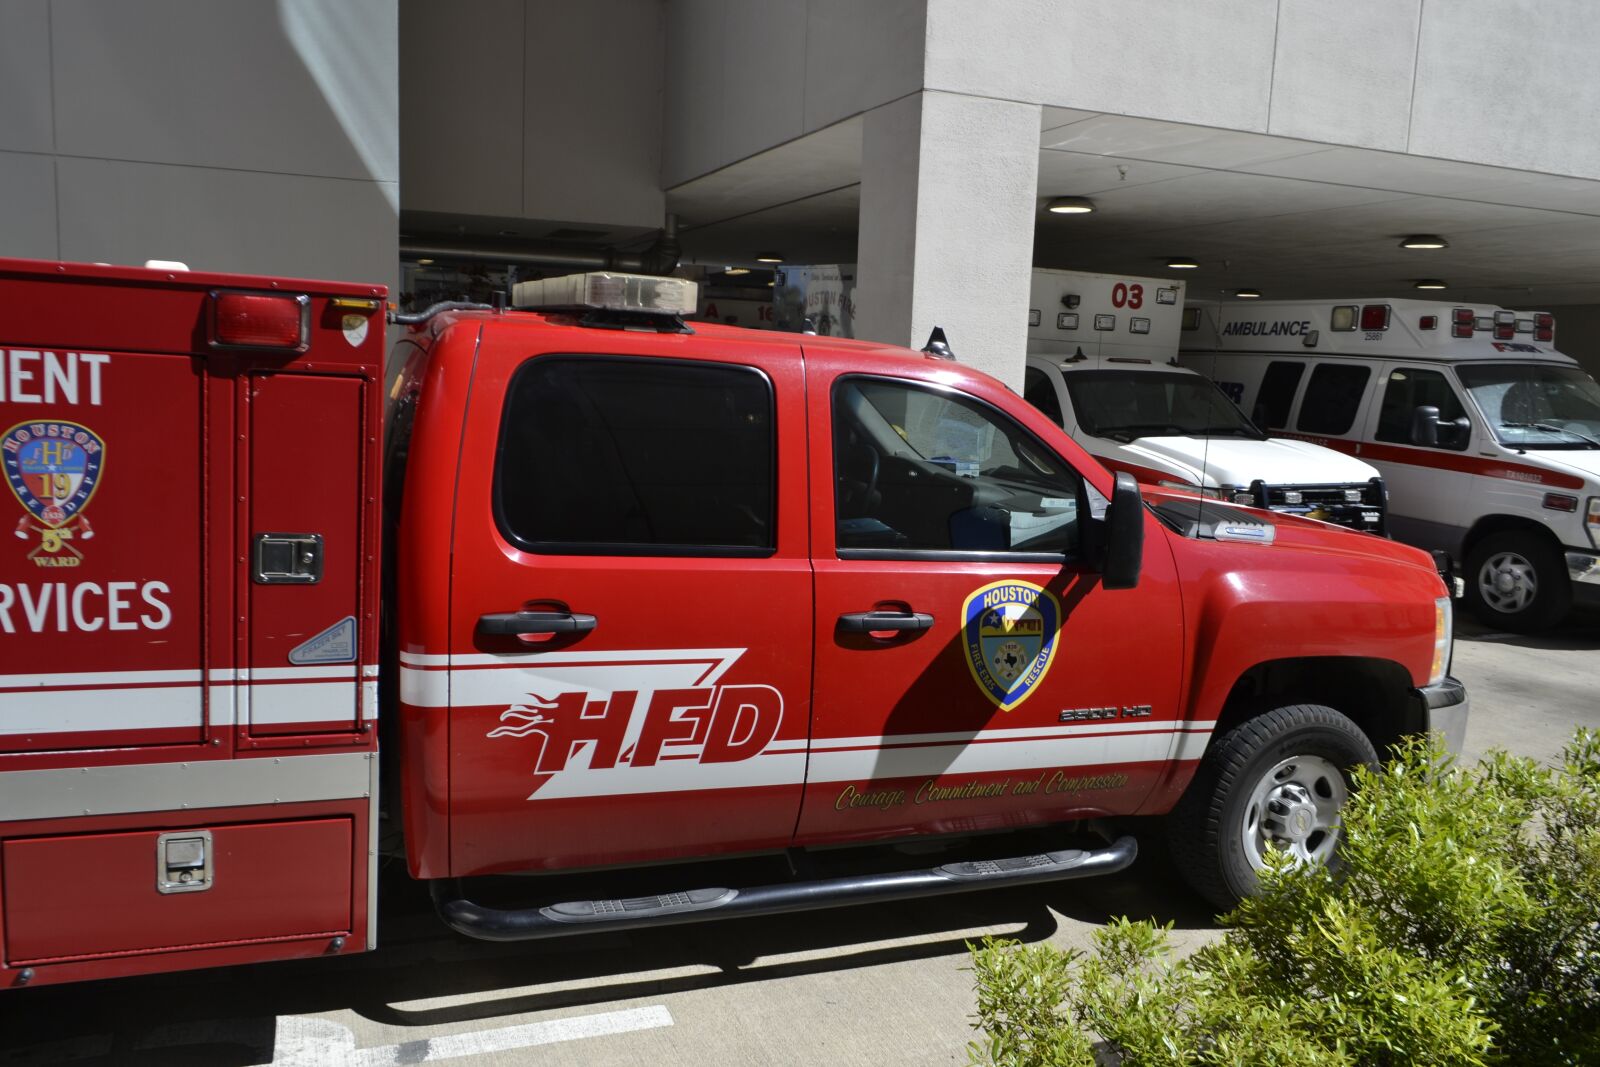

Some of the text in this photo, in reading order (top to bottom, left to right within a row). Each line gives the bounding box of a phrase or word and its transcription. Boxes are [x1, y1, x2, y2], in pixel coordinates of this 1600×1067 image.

[1111, 283, 1144, 309] 03
[704, 303, 719, 319] A
[1222, 321, 1310, 336] AMBULANCE
[2, 423, 101, 454] HOUSTON
[7, 460, 40, 509] FIRE
[37, 473, 72, 500] 19
[65, 462, 98, 512] DEPT
[33, 556, 81, 567] WARD
[983, 586, 1040, 608] HOUSTON
[1024, 646, 1050, 687] RESCUE
[1059, 704, 1152, 722] 2500 HD
[530, 684, 784, 775] HFD
[914, 779, 1010, 805] Commitment
[1013, 770, 1045, 797] and
[1045, 769, 1129, 798] Compassion
